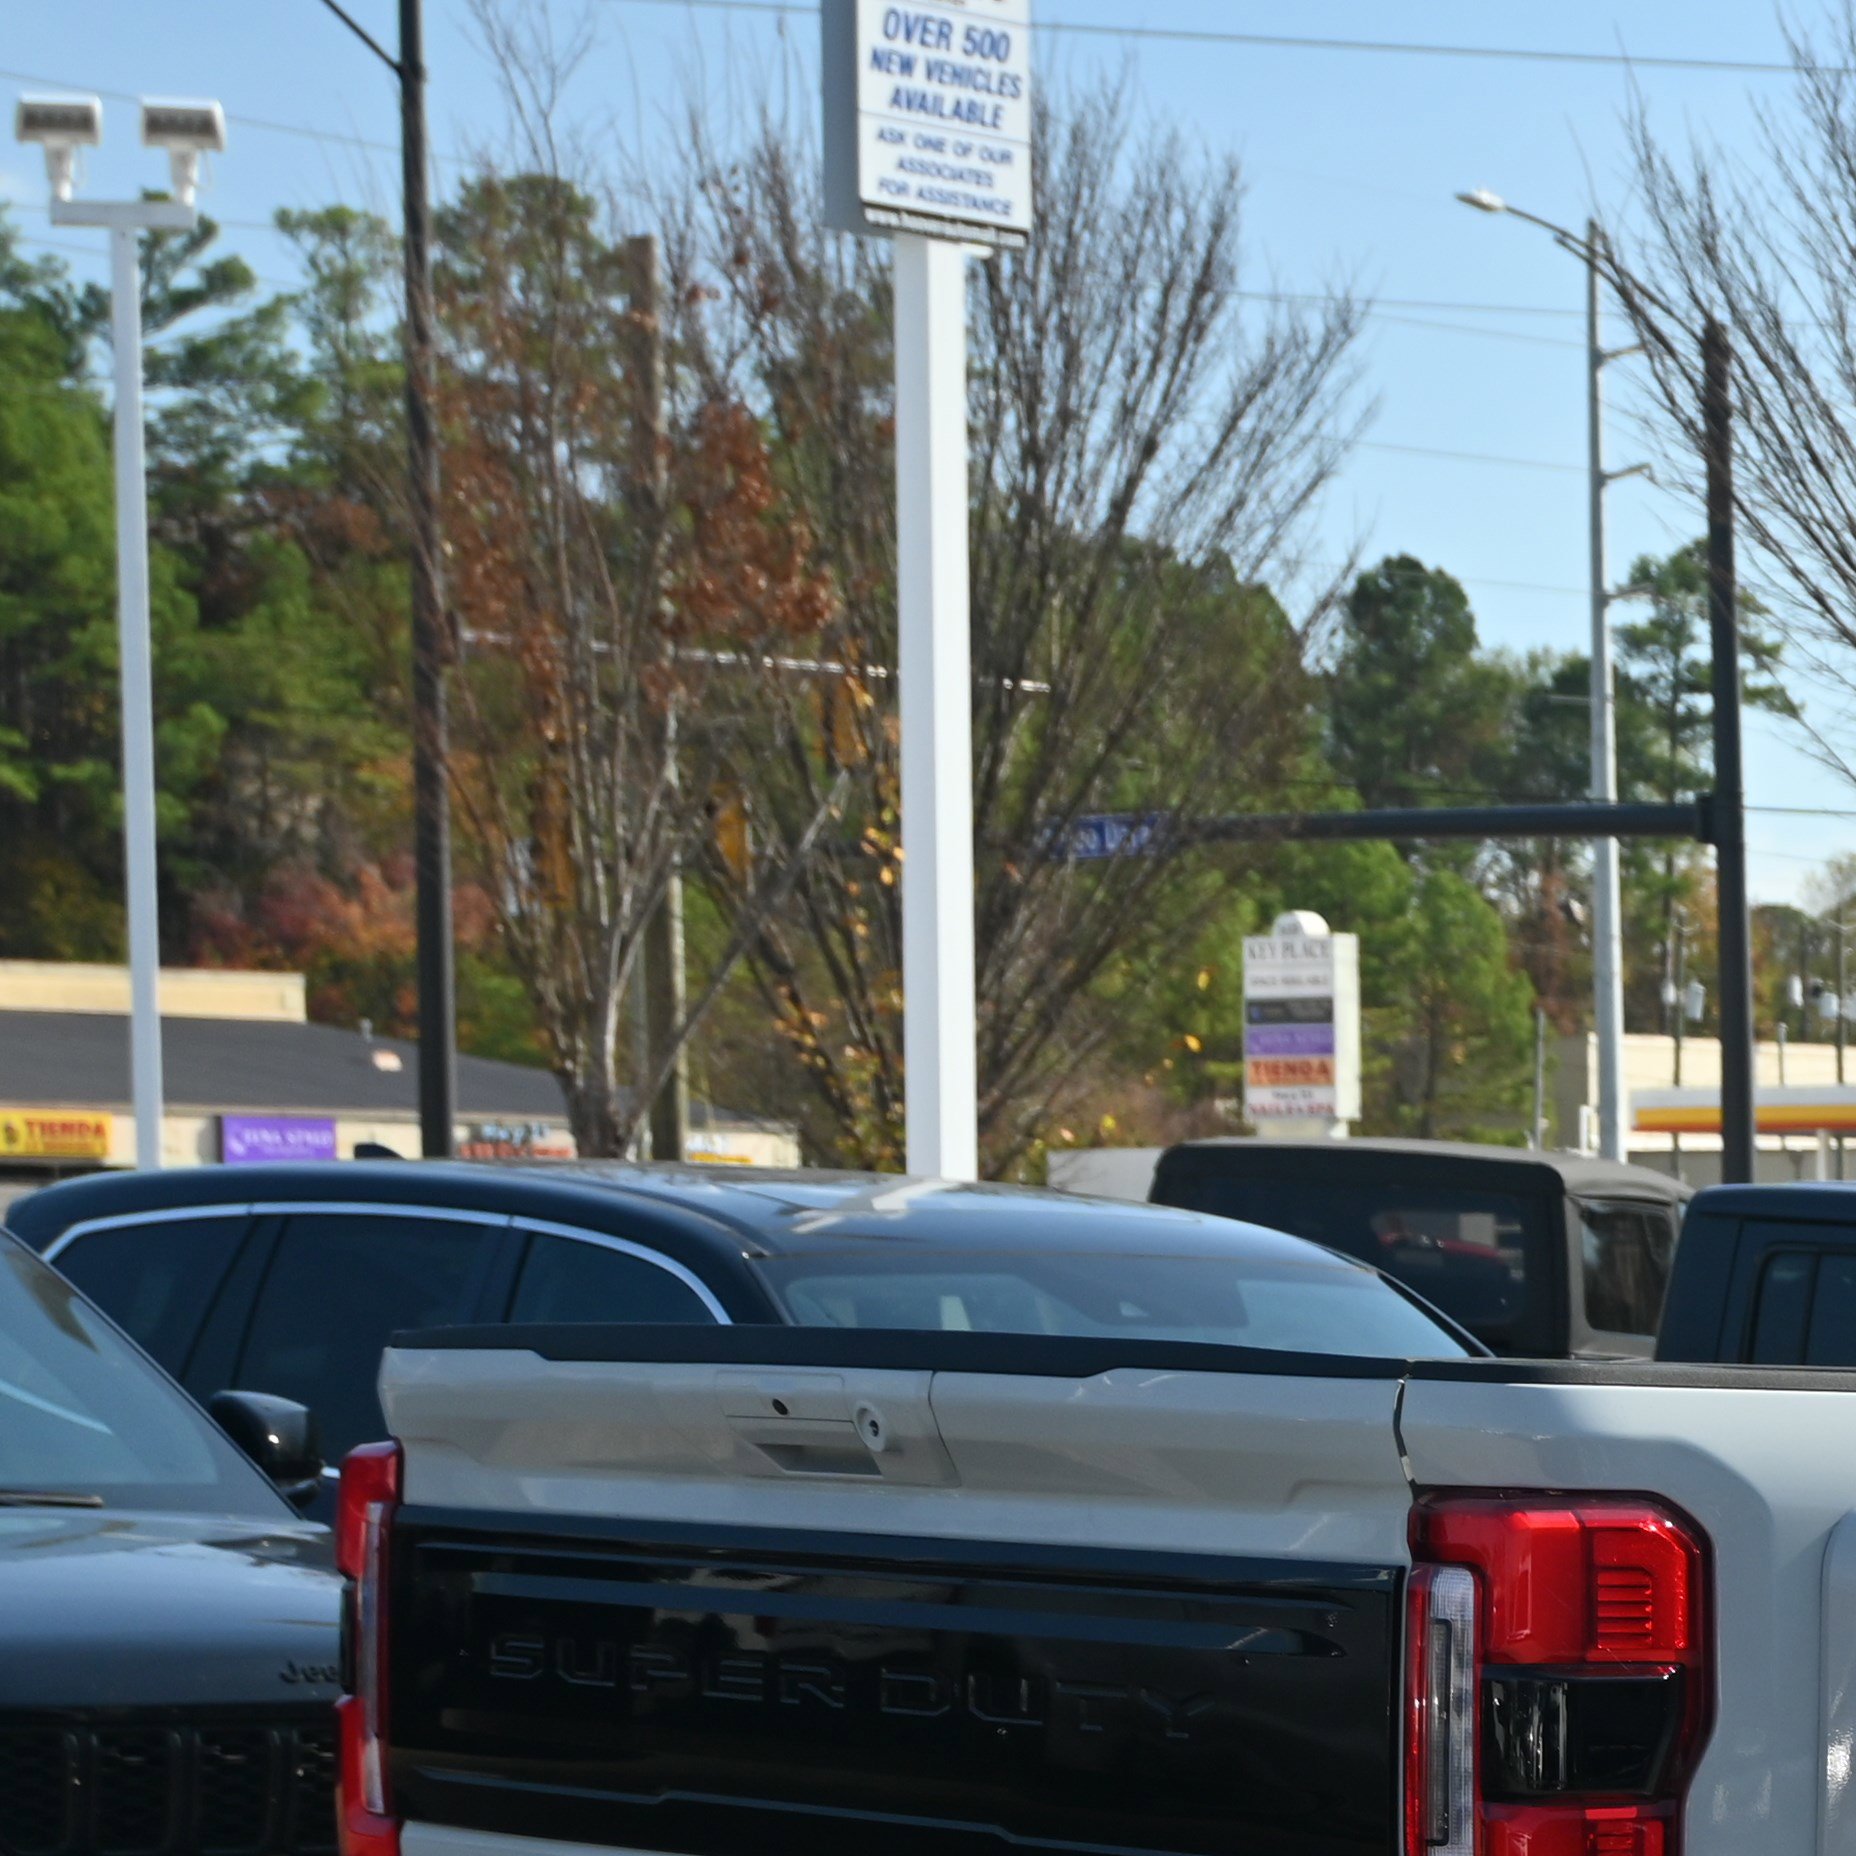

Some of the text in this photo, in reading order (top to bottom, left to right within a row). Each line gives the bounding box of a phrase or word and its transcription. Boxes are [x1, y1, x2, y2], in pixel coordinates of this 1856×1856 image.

[883, 7, 1011, 63] OVER 500
[871, 47, 1022, 99] NEW VEHICLES
[890, 86, 1005, 130] AVAILABLE
[877, 126, 1014, 165] ASK ONE OF OUR
[896, 156, 995, 189] ASSOCIATES
[878, 177, 1013, 216] FOR ASSISTANCE
[1250, 1060, 1331, 1077] TIENDA
[25, 1119, 106, 1137] TIENDA
[279, 1660, 339, 1684] Jee
[490, 1634, 1215, 1738] SUPER DUTY
